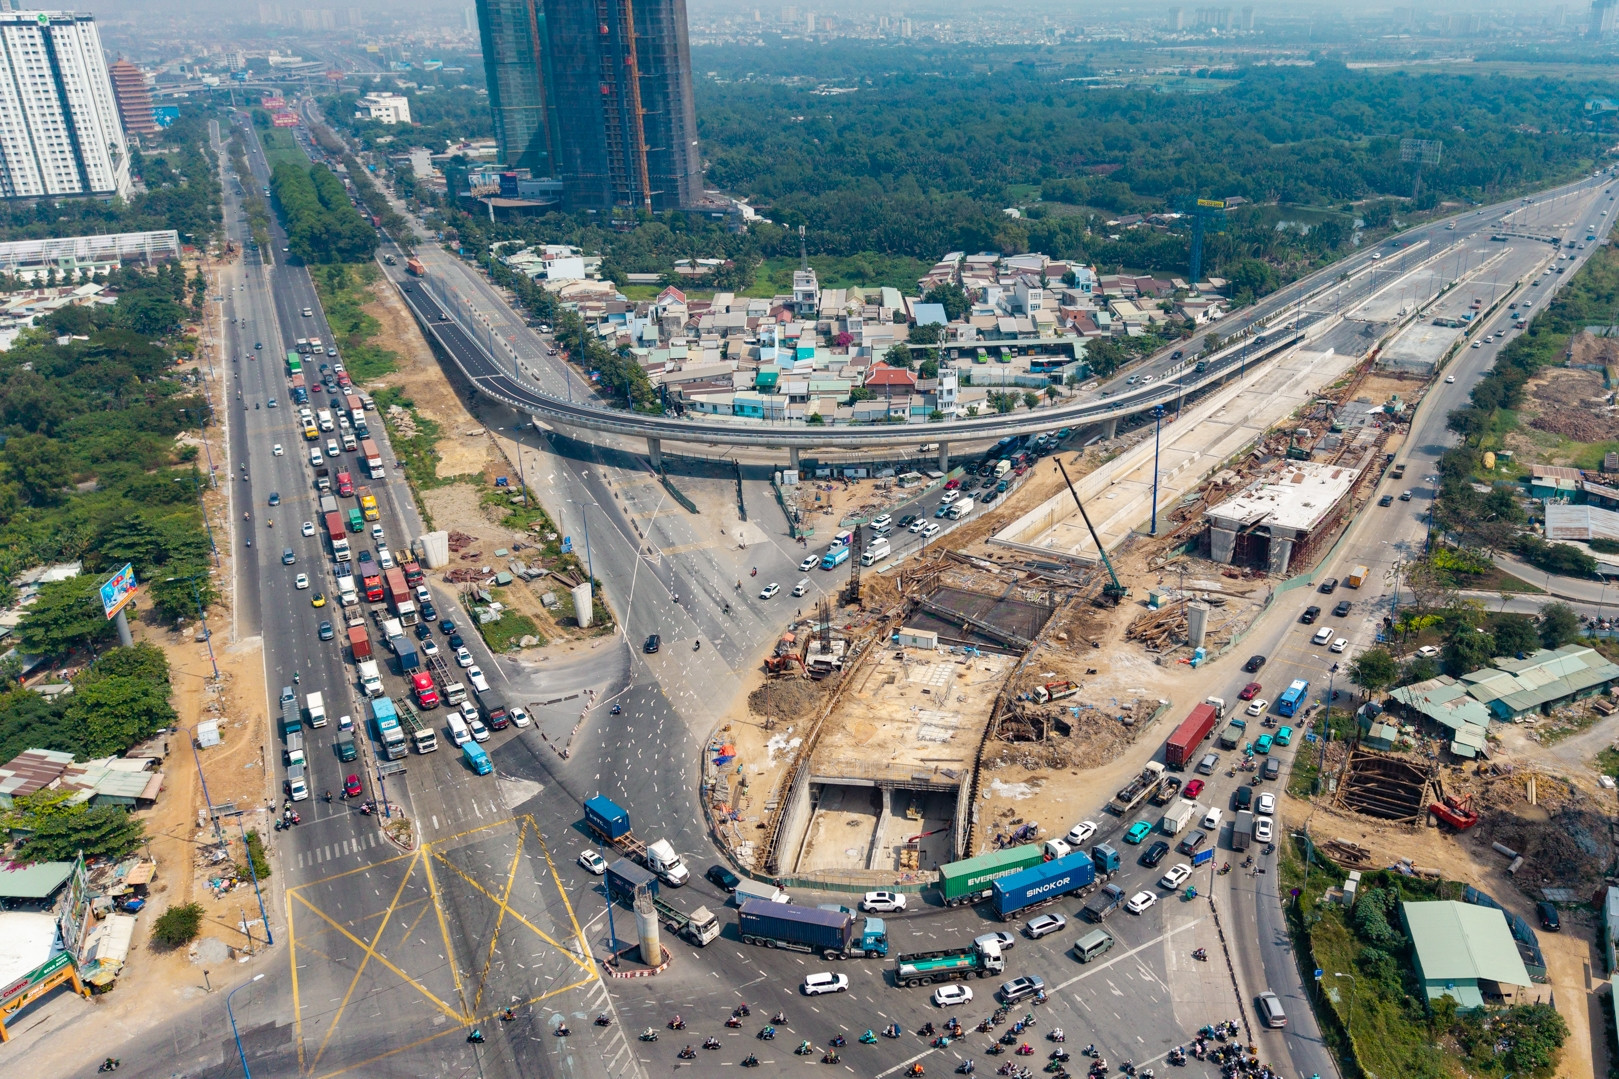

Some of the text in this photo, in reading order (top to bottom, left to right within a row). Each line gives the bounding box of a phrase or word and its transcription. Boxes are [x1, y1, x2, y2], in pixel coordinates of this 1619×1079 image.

[968, 866, 1023, 886] EVERGREEN
[1026, 877, 1070, 897] SINOKOR
[3, 979, 28, 997] Castrol
